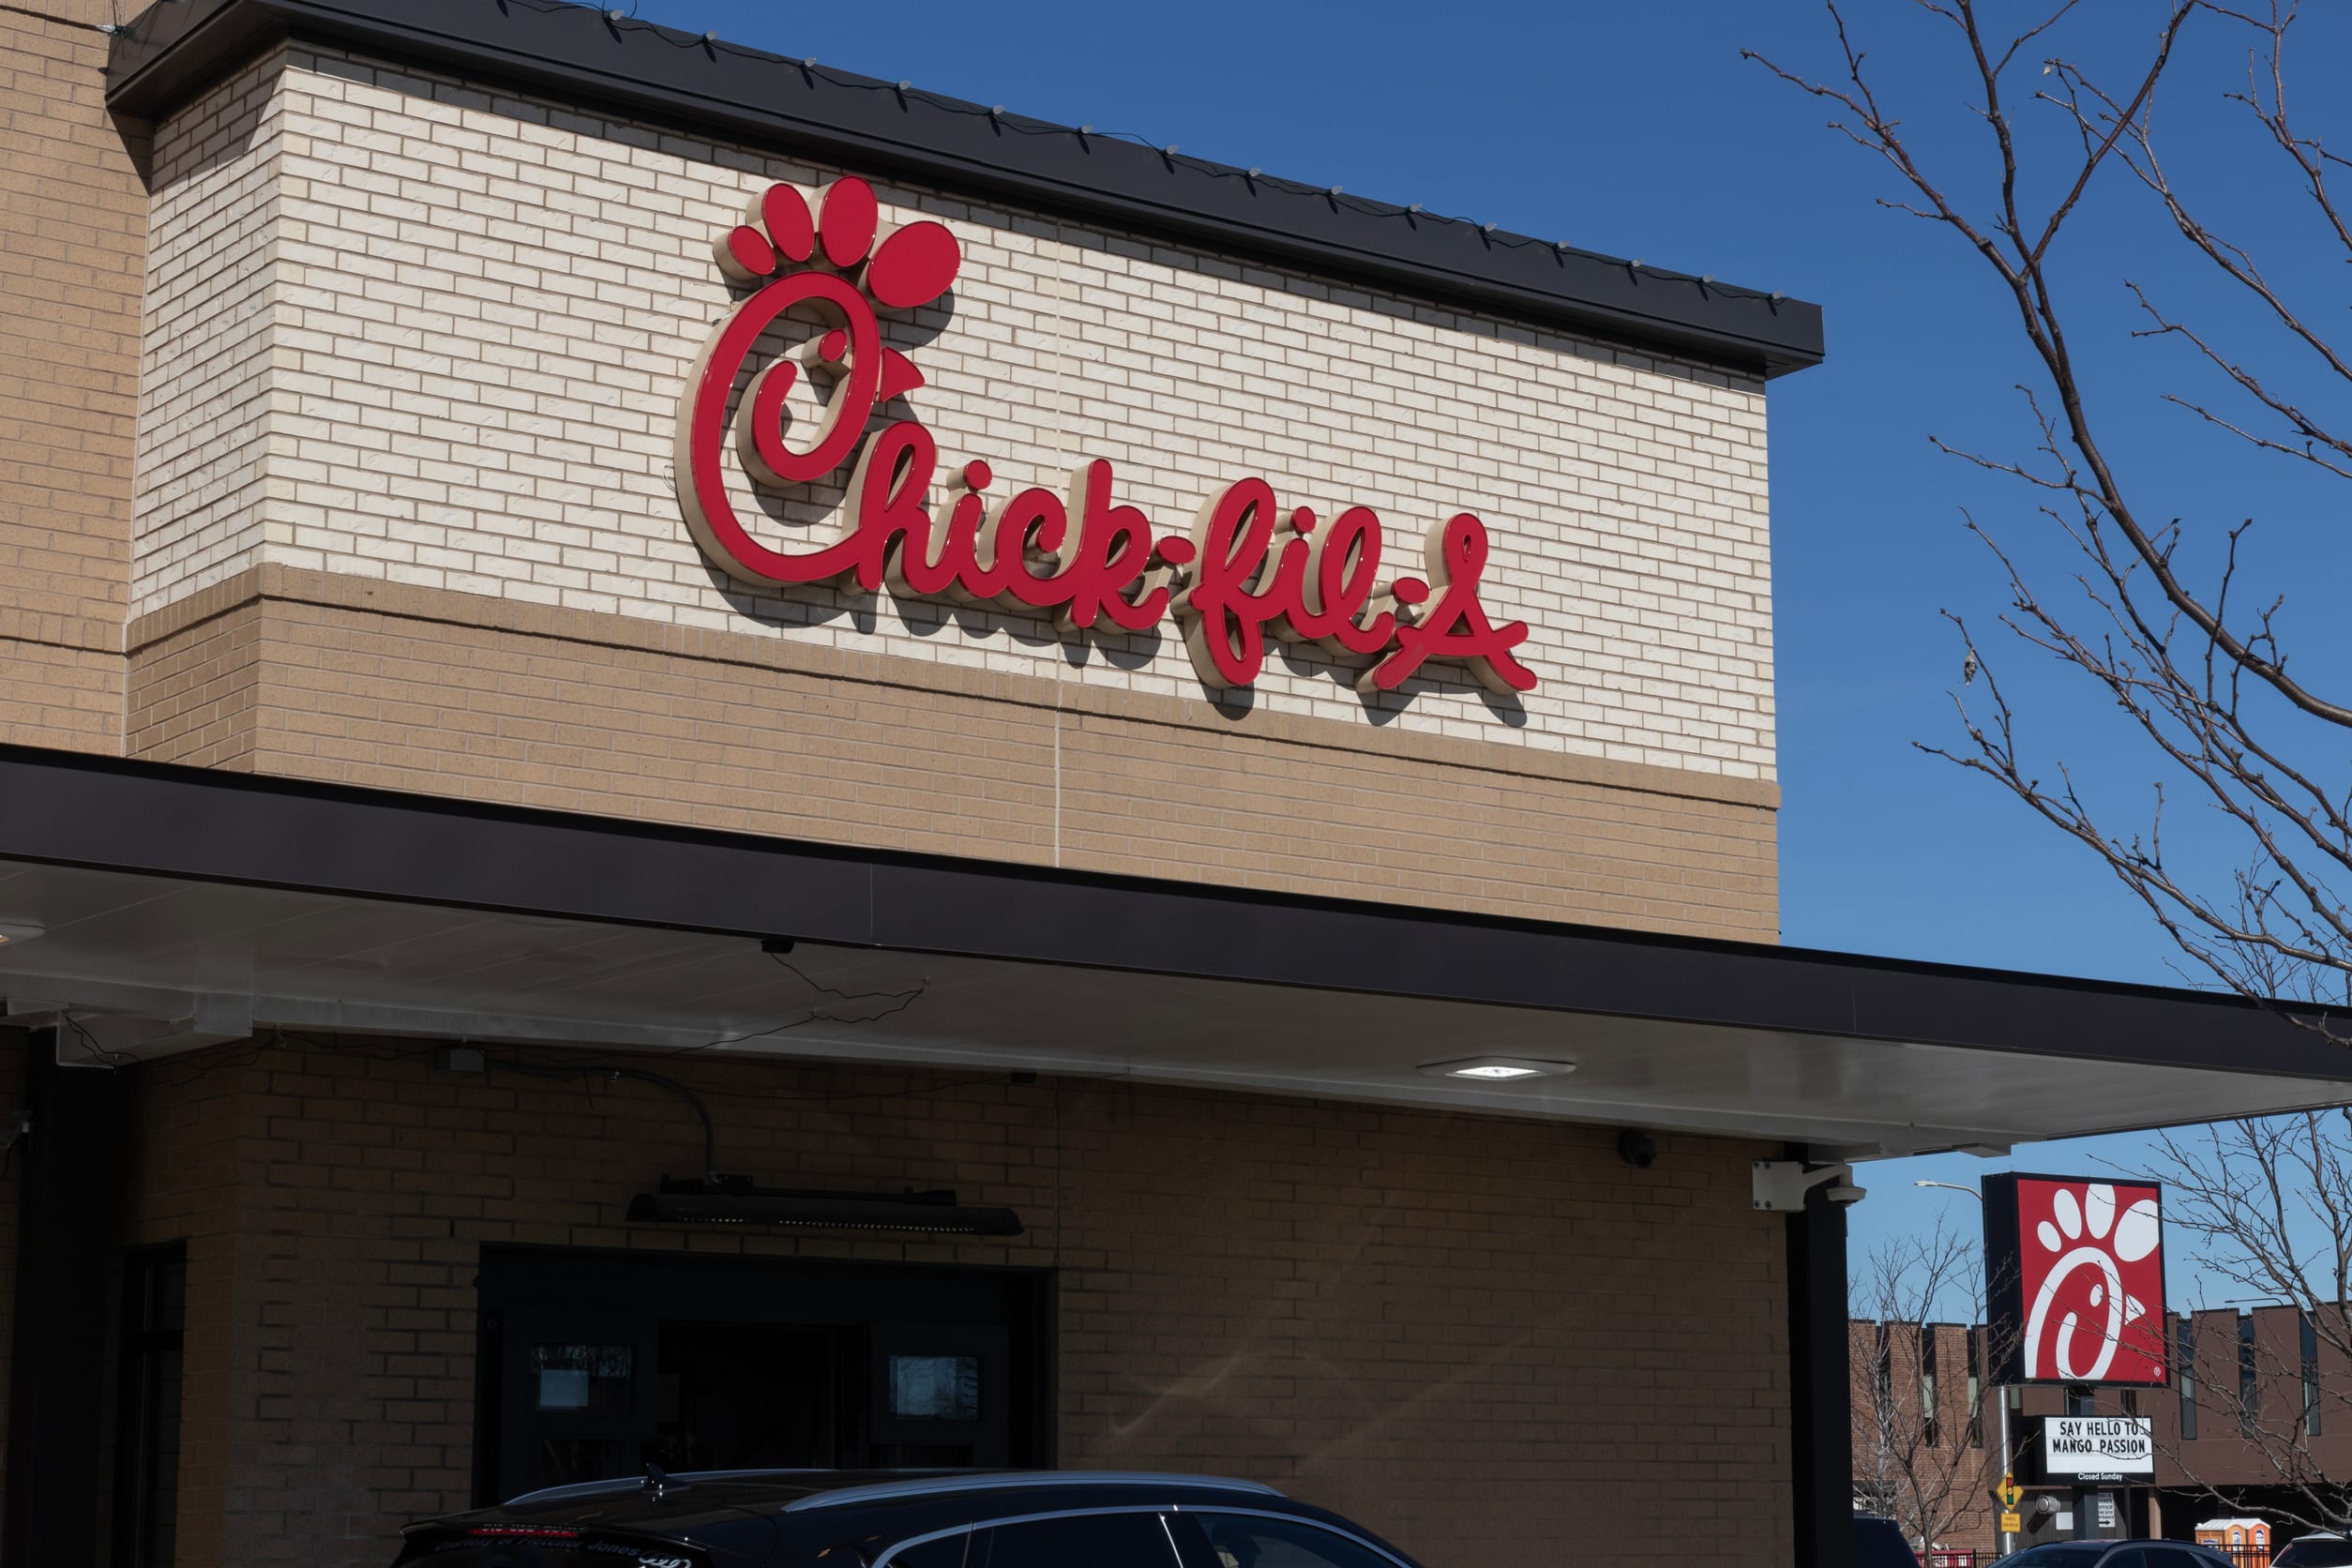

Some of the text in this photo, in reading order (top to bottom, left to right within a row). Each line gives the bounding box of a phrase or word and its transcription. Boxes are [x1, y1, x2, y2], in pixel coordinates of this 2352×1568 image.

[689, 270, 1538, 692] Chick-fil-A
[2059, 1421, 2139, 1436] SAY HELLO TO
[2052, 1439, 2146, 1453] MANGO PASSION
[2077, 1471, 2123, 1483] Closed Sunday
[587, 1540, 641, 1556] Jones
